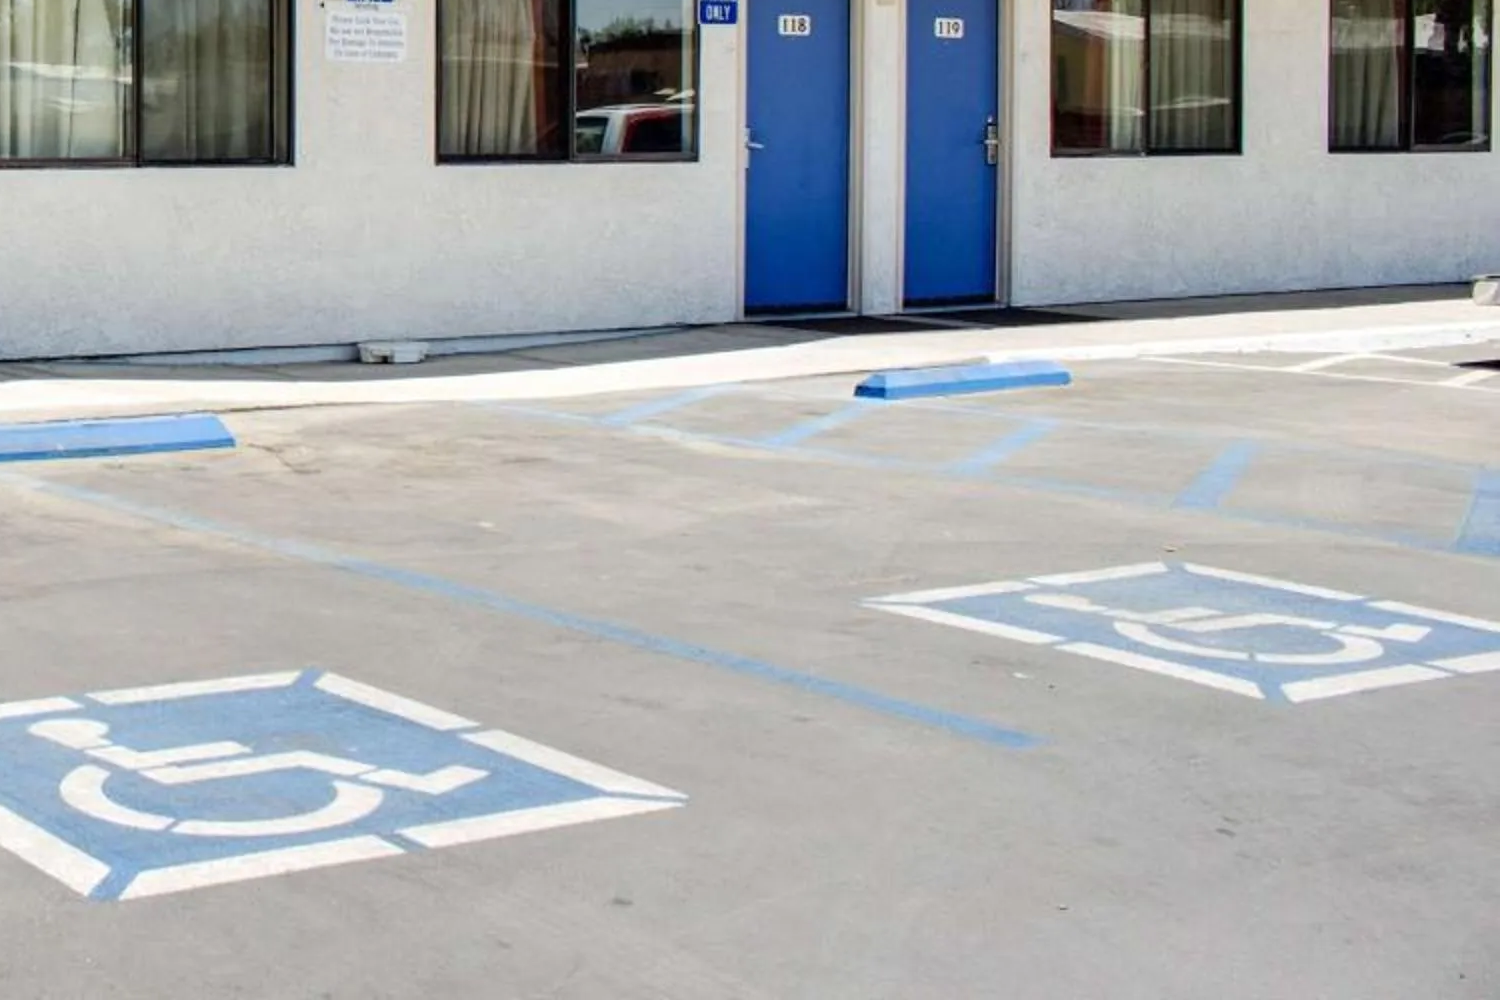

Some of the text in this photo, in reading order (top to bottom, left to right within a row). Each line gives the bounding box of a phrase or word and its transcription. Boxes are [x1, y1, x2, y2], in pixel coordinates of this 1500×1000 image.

[705, 4, 731, 21] ONLY
[783, 17, 807, 32] 118
[938, 21, 960, 35] 119
